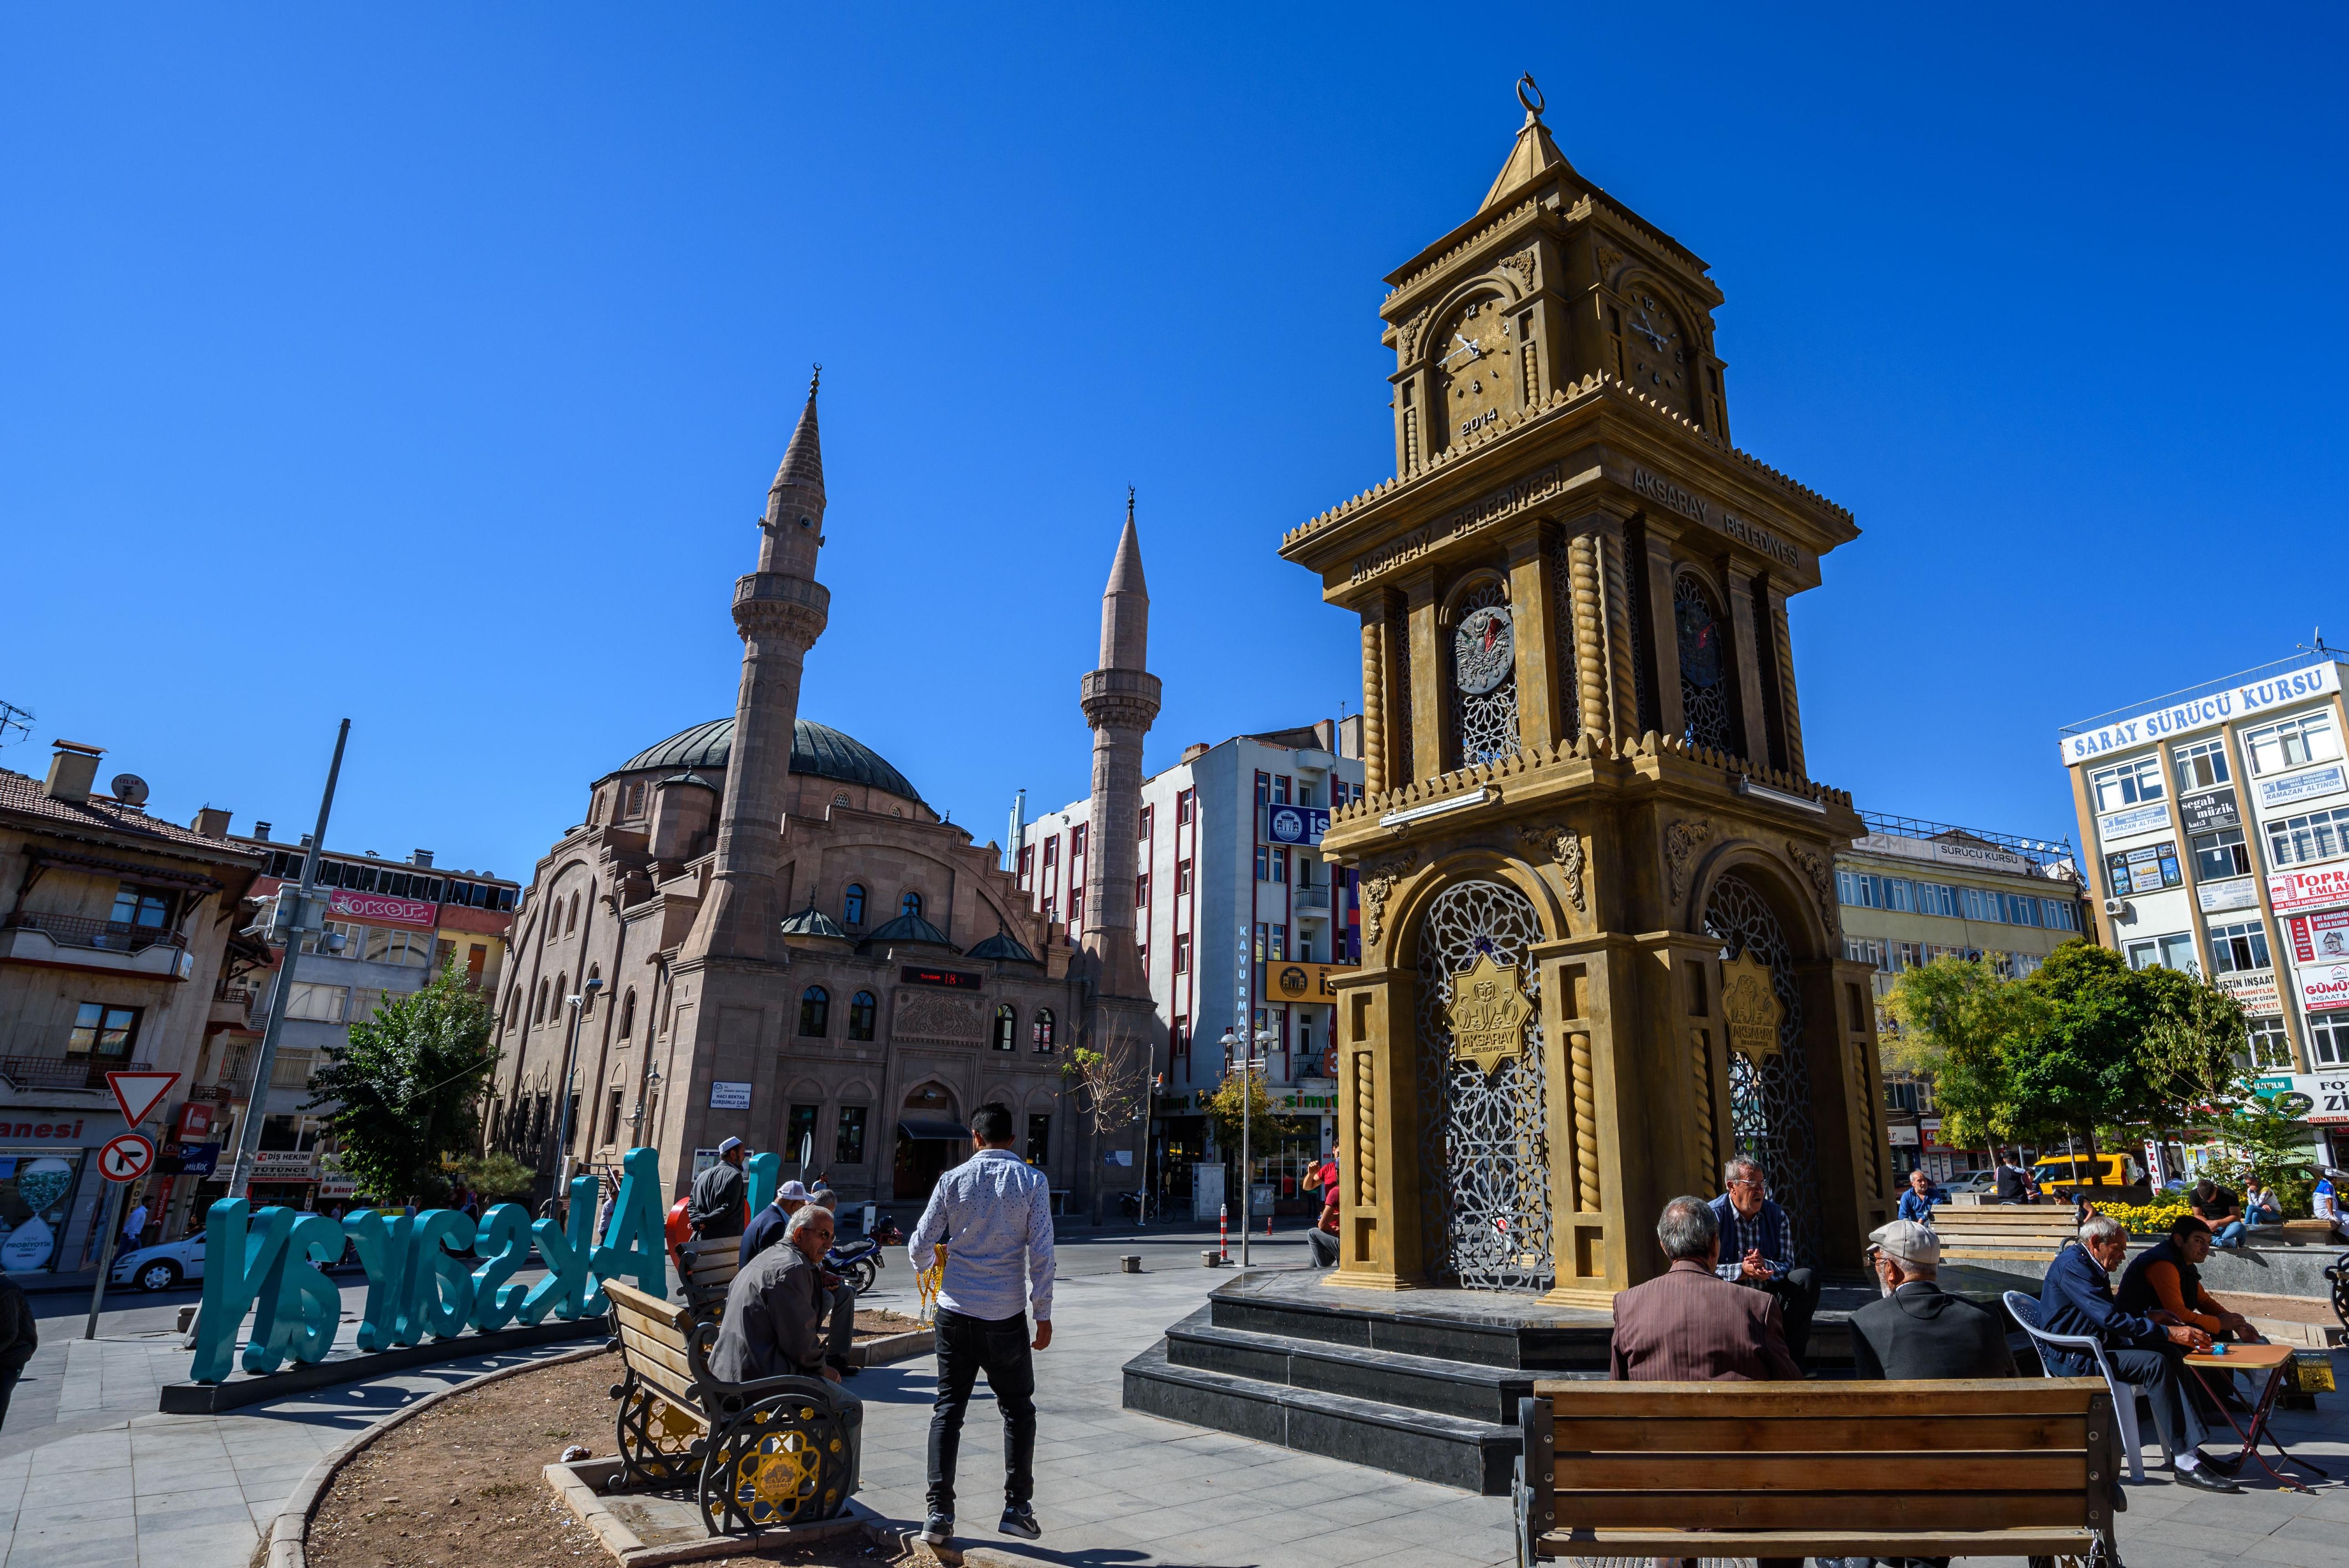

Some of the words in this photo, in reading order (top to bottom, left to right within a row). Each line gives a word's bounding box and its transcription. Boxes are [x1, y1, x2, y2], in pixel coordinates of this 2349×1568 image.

[1464, 304, 1477, 318] 12
[1644, 296, 1655, 312] 12
[1503, 322, 1510, 336] 3
[1677, 351, 1683, 363] 3
[1654, 372, 1661, 384] 6
[1472, 380, 1479, 393] 6
[1461, 407, 1497, 436] 2014
[1350, 529, 1431, 585] AKSARAY
[1452, 464, 1564, 539] BELEDİYESİ
[1634, 468, 1707, 522] AKSARAY
[1724, 514, 1801, 570] BELEDİYESİ
[2075, 722, 2138, 757] SARAY
[2147, 692, 2232, 736] SÜRÜCÜ
[2243, 669, 2323, 710] KURSU
[2266, 788, 2302, 800] RAMAZAN
[2307, 779, 2341, 791] ALTINOK
[2182, 795, 2215, 810] segah
[2197, 803, 2234, 818] müzik
[2106, 823, 2136, 834] RAMAZAN
[2139, 816, 2167, 826] ALTINOK
[2188, 820, 2206, 828] kat:3
[1941, 845, 1983, 859] SÜRÜCÜ
[1985, 852, 2018, 864] KURSU
[2293, 870, 2349, 888] TOPR
[2302, 895, 2335, 904] GAYRİMENKUL
[945, 973, 956, 985] 18
[2244, 975, 2275, 988] İNŞAAT
[1237, 926, 1247, 1057] KAVURMACI
[1462, 1030, 1515, 1047] AKSARAY
[1733, 1025, 1773, 1041] AKSARAY
[1471, 1044, 1506, 1053] BELEDİYESİ
[267, 1152, 280, 1161] DİŞ
[283, 1152, 310, 1161] HEKİMİ
[157, 1188, 169, 1217] vodafone
